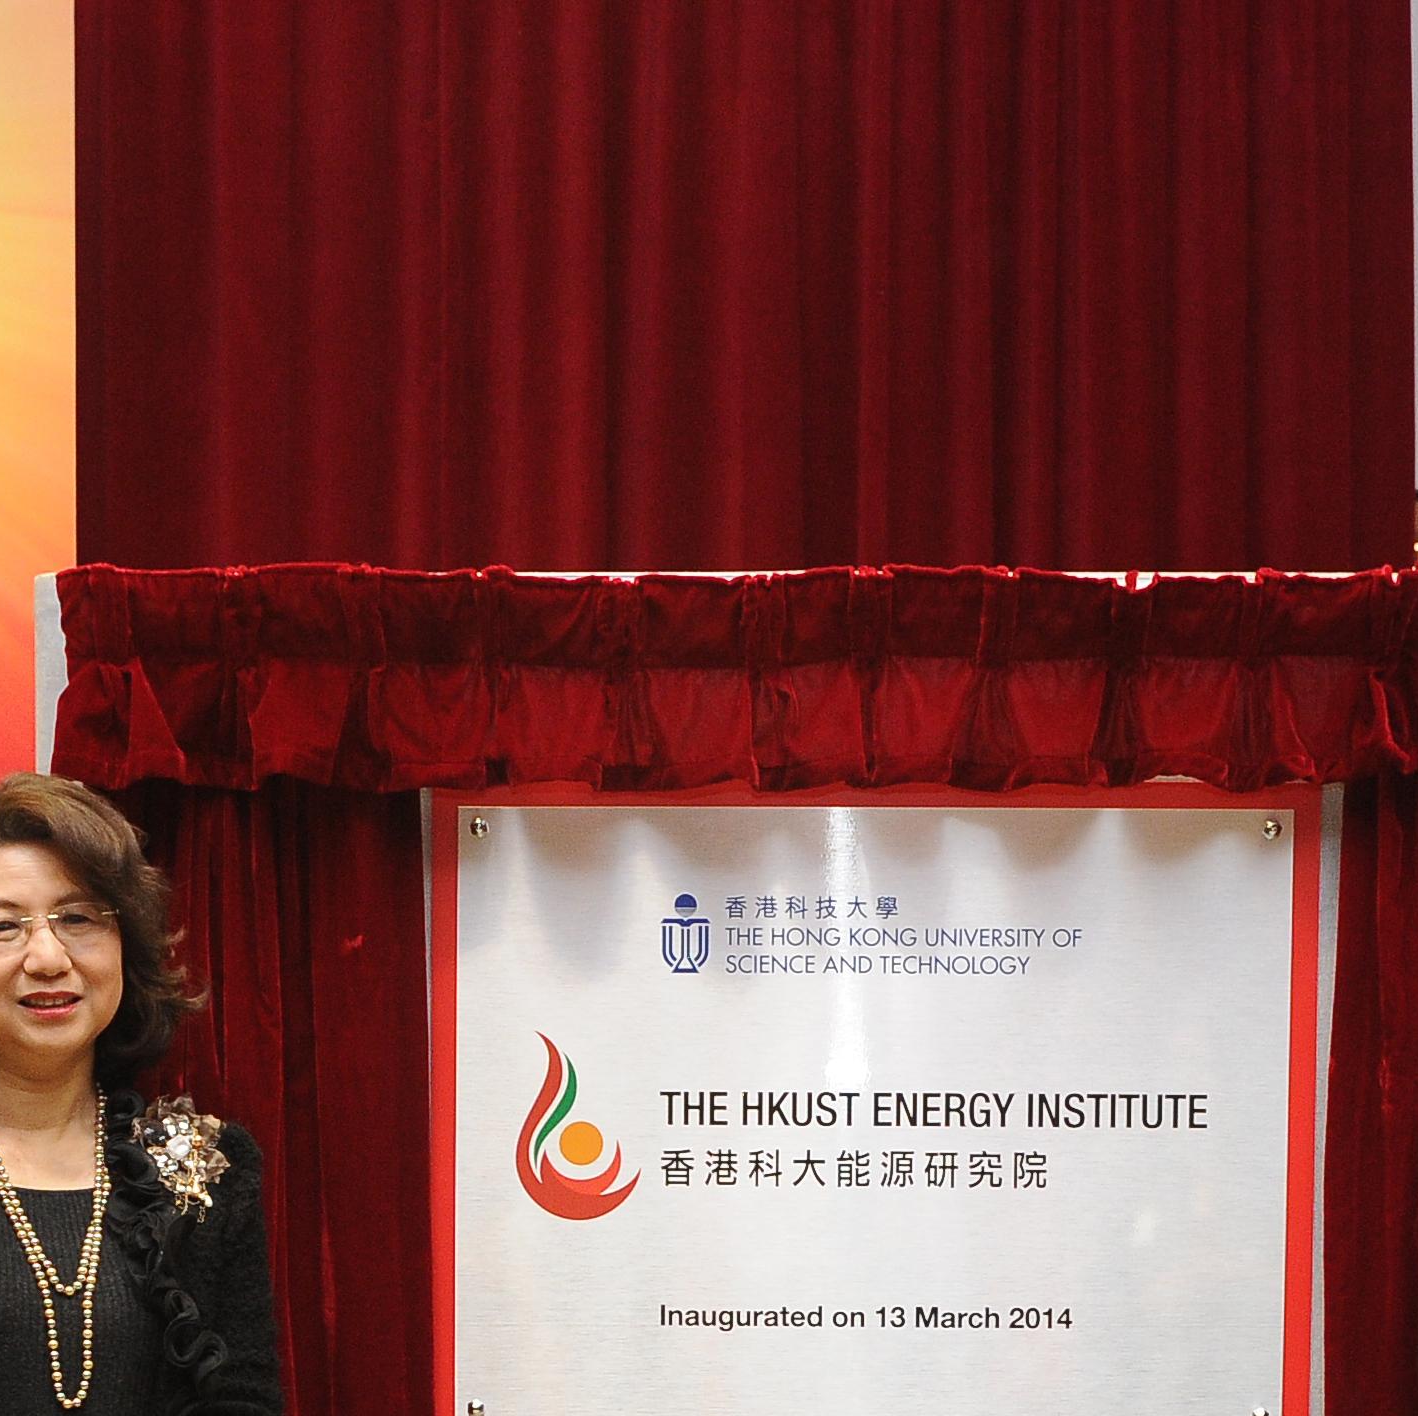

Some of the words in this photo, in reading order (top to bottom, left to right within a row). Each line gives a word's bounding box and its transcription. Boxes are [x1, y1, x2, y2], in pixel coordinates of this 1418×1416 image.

[725, 895, 900, 920] 香港科技大學
[726, 928, 764, 947] THE
[772, 928, 842, 948] HONG
[850, 928, 919, 948] KONG
[925, 929, 1047, 948] UNIVERSITY
[1052, 929, 1084, 949] OF
[726, 955, 817, 975] SCIENCE
[823, 956, 874, 975] AND
[880, 956, 1032, 976] TECHNOLOGY
[660, 1092, 730, 1127] THE
[742, 1092, 861, 1129] HKUST
[873, 1093, 1016, 1129] ENERGY
[1028, 1093, 1209, 1130] INSTITUTE
[660, 1149, 1049, 1191] 香港科大能源研究院
[660, 1304, 824, 1334] Inaugurated
[833, 1312, 866, 1329] on
[876, 1307, 907, 1329] 13
[915, 1307, 1001, 1330] March
[1009, 1308, 1074, 1330] 2014
